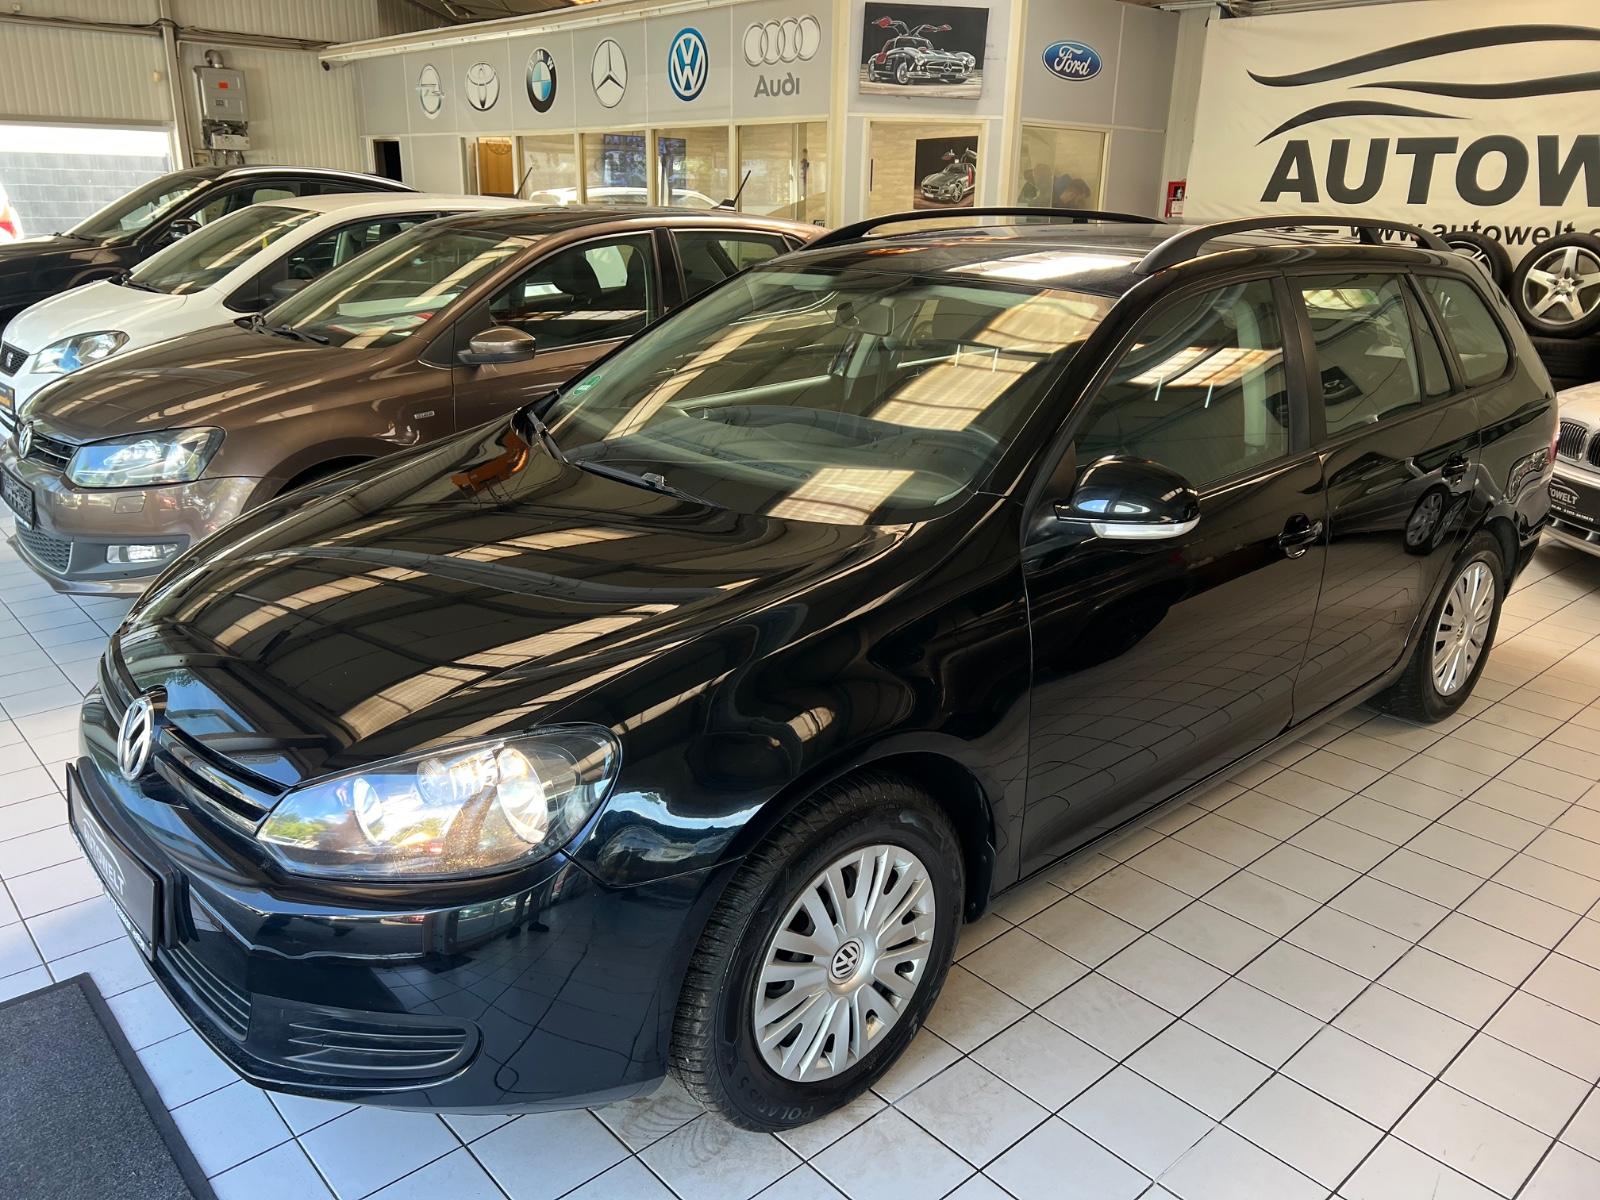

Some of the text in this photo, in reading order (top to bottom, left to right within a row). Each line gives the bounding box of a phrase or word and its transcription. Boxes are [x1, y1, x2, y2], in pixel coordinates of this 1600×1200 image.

[670, 32, 707, 97] VW
[1054, 45, 1091, 75] Ford
[754, 72, 800, 97] Audi
[1550, 488, 1577, 505] OWELT
[831, 941, 860, 979] VW
